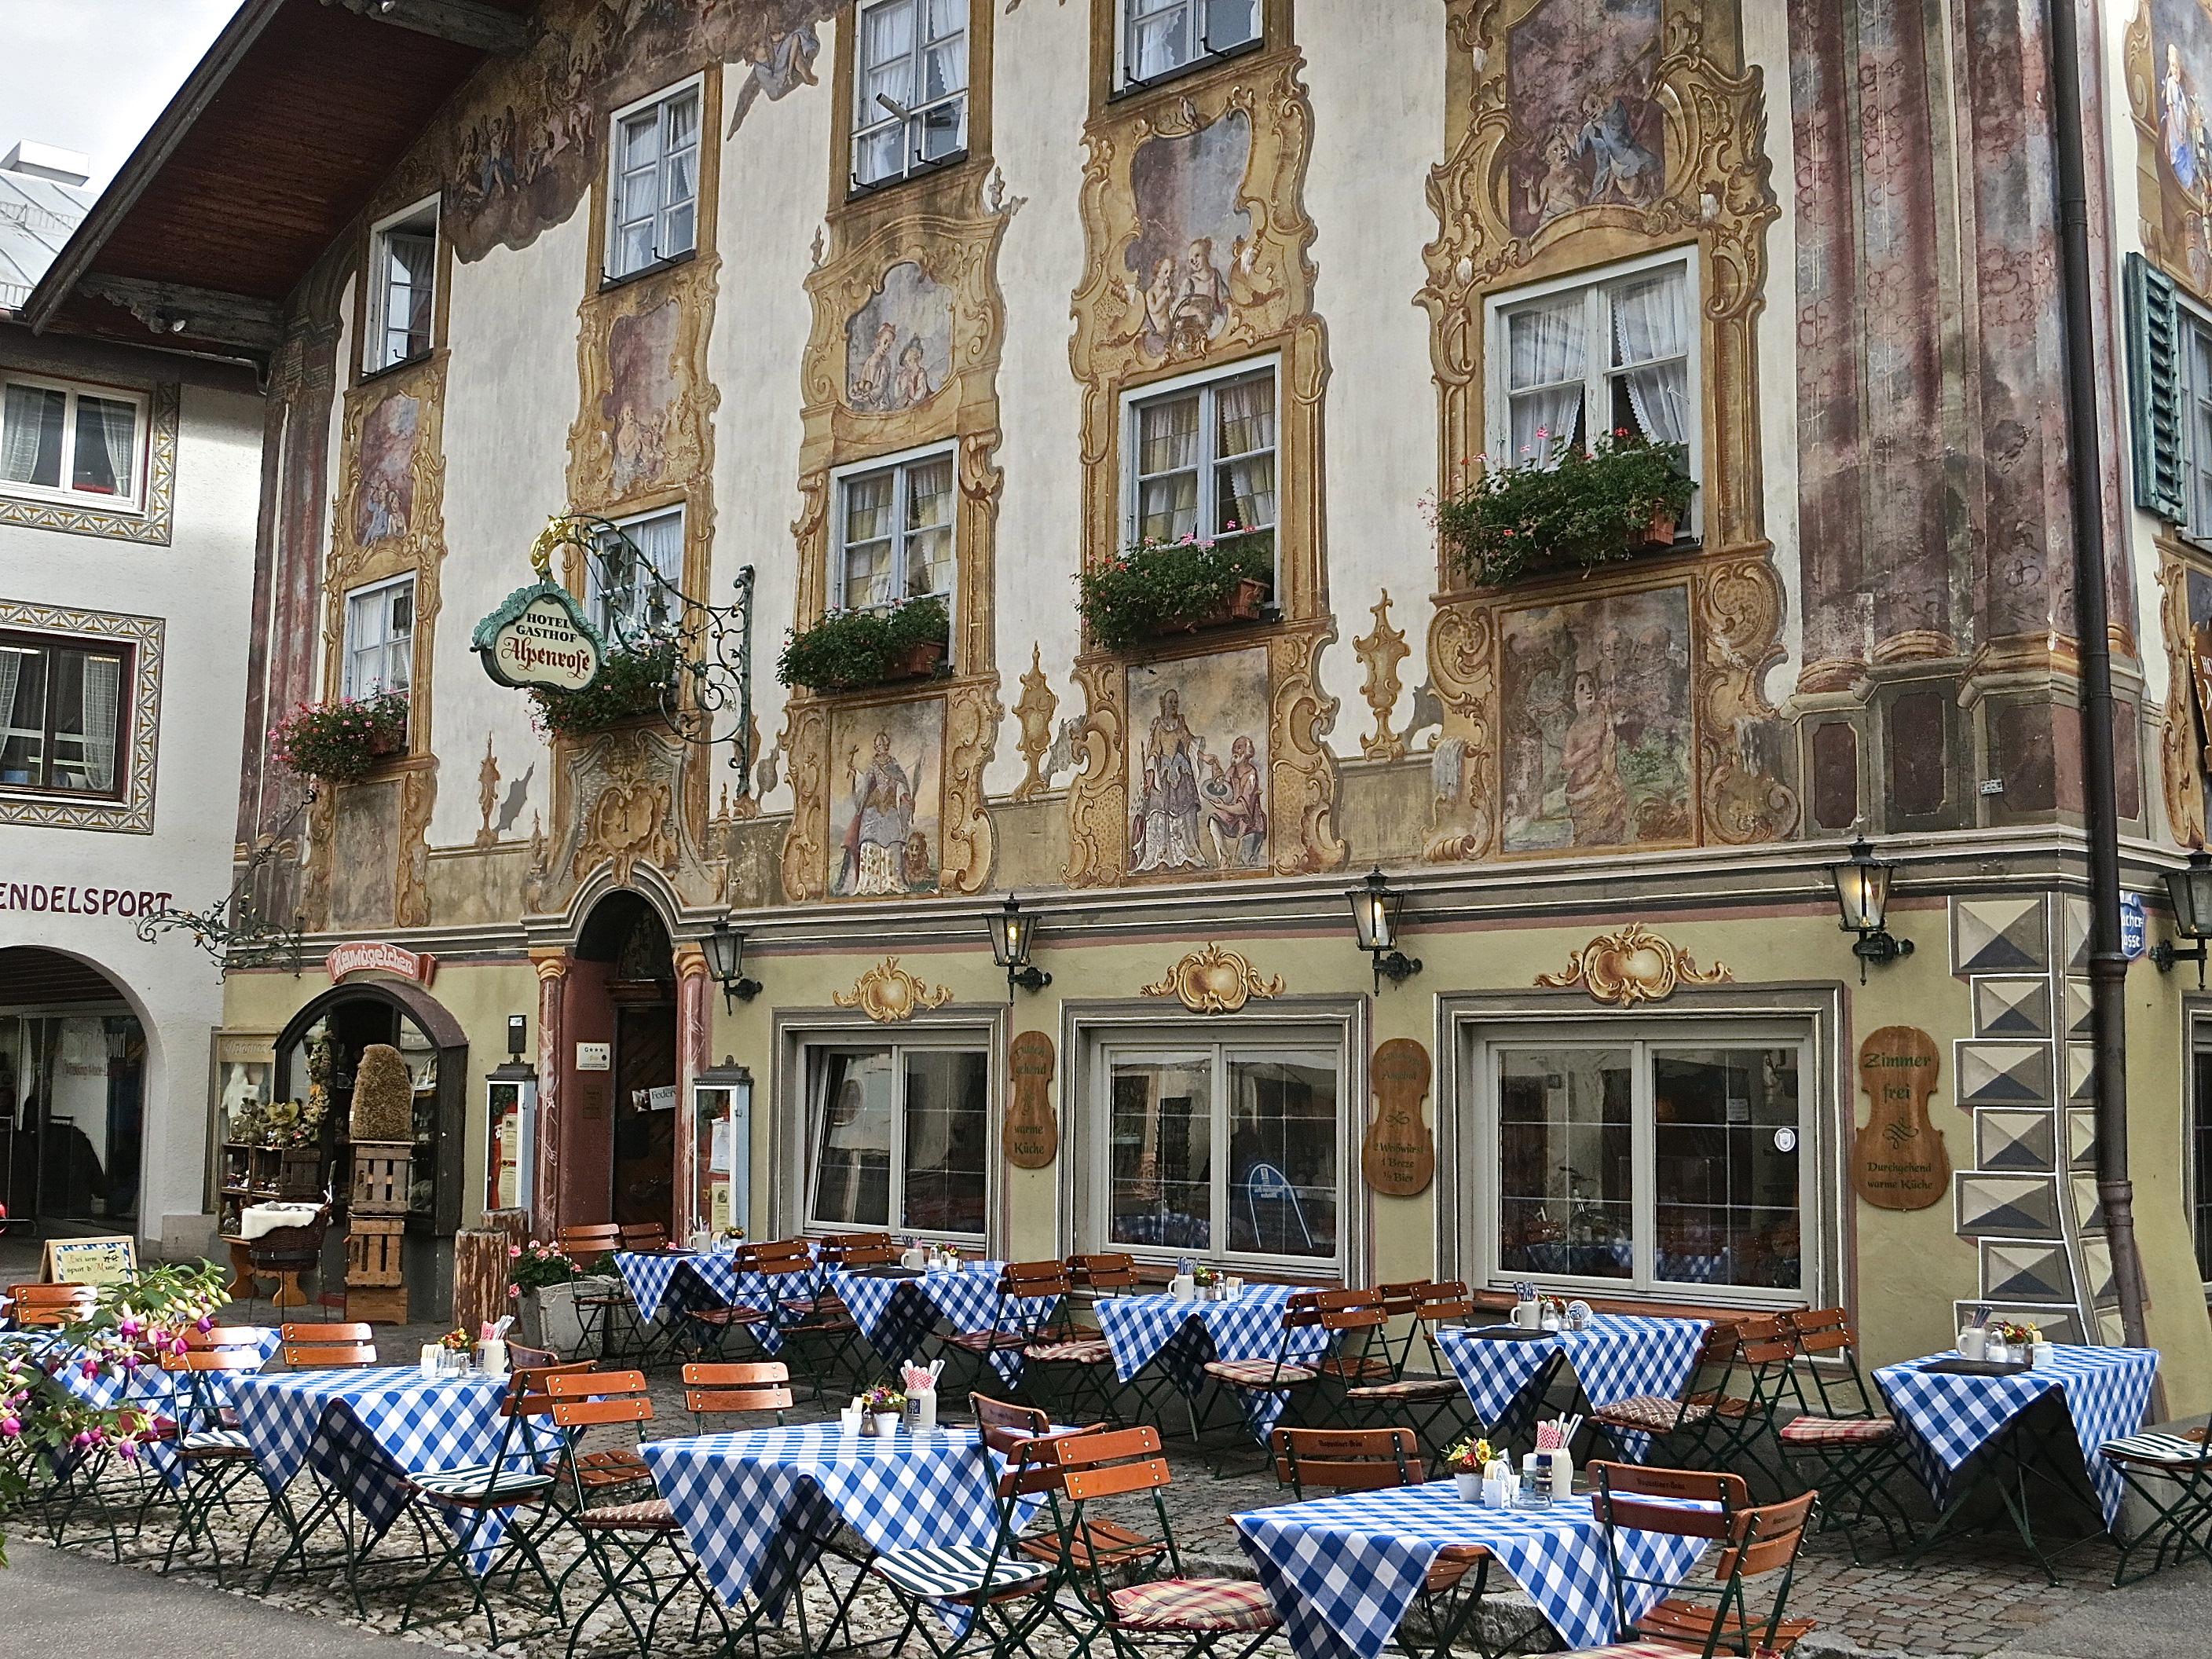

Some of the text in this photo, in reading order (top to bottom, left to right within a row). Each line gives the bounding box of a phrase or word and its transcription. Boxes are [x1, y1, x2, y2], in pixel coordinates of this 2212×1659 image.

[526, 613, 569, 629] HOTEL
[515, 624, 577, 643] GASTHOF
[501, 637, 590, 679] Alpenrose
[1863, 1052, 1932, 1068] Zimmer
[1882, 1082, 1910, 1104] frei
[1014, 1125, 1044, 1135] warme
[1014, 1141, 1045, 1155] Küche
[1867, 1162, 1932, 1174] Durchgehend
[1393, 1173, 1414, 1181] Bier
[1867, 1180, 1933, 1190] warme Küche
